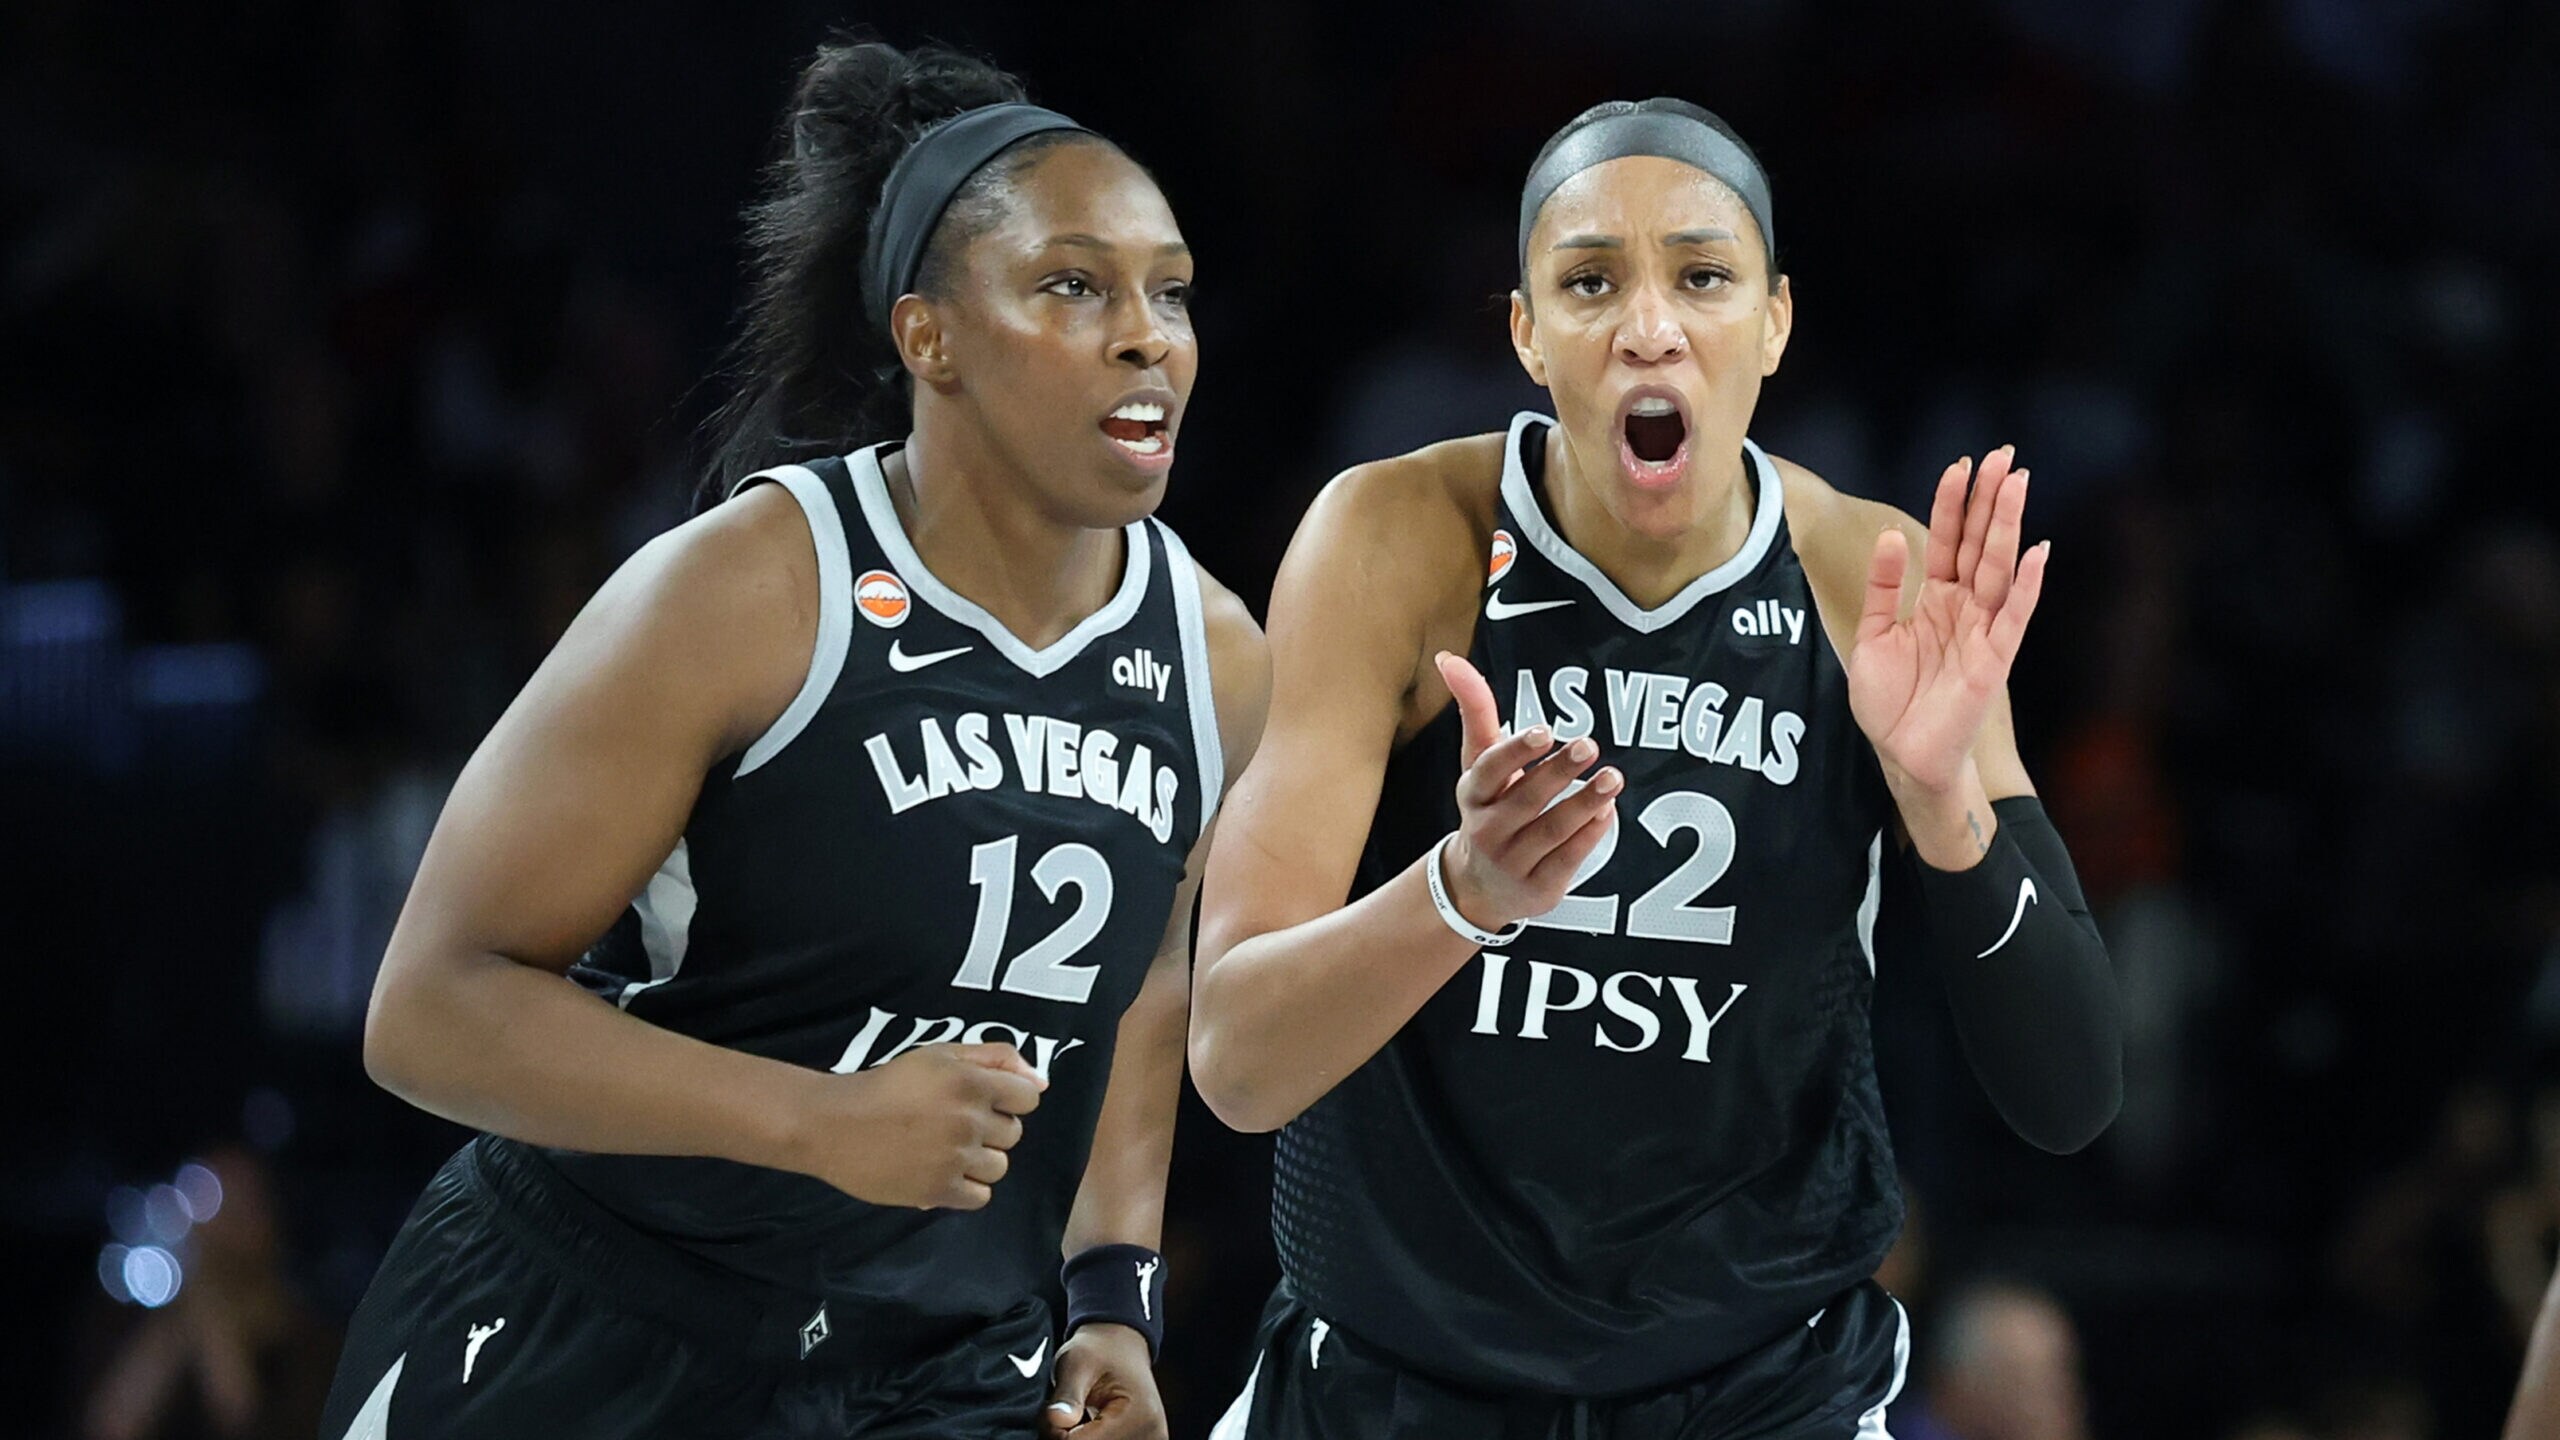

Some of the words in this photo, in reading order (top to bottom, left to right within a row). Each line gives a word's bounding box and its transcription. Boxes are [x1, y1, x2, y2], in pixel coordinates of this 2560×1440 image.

[1112, 647, 1172, 703] ally
[1731, 598, 1806, 645] ally
[863, 712, 1003, 815] LAS
[1003, 713, 1179, 844] VEGAS
[1500, 666, 1596, 743] AS
[1605, 667, 1807, 786] VEGAS
[950, 834, 1114, 1004] 12
[1470, 952, 1748, 1063] IPSY
